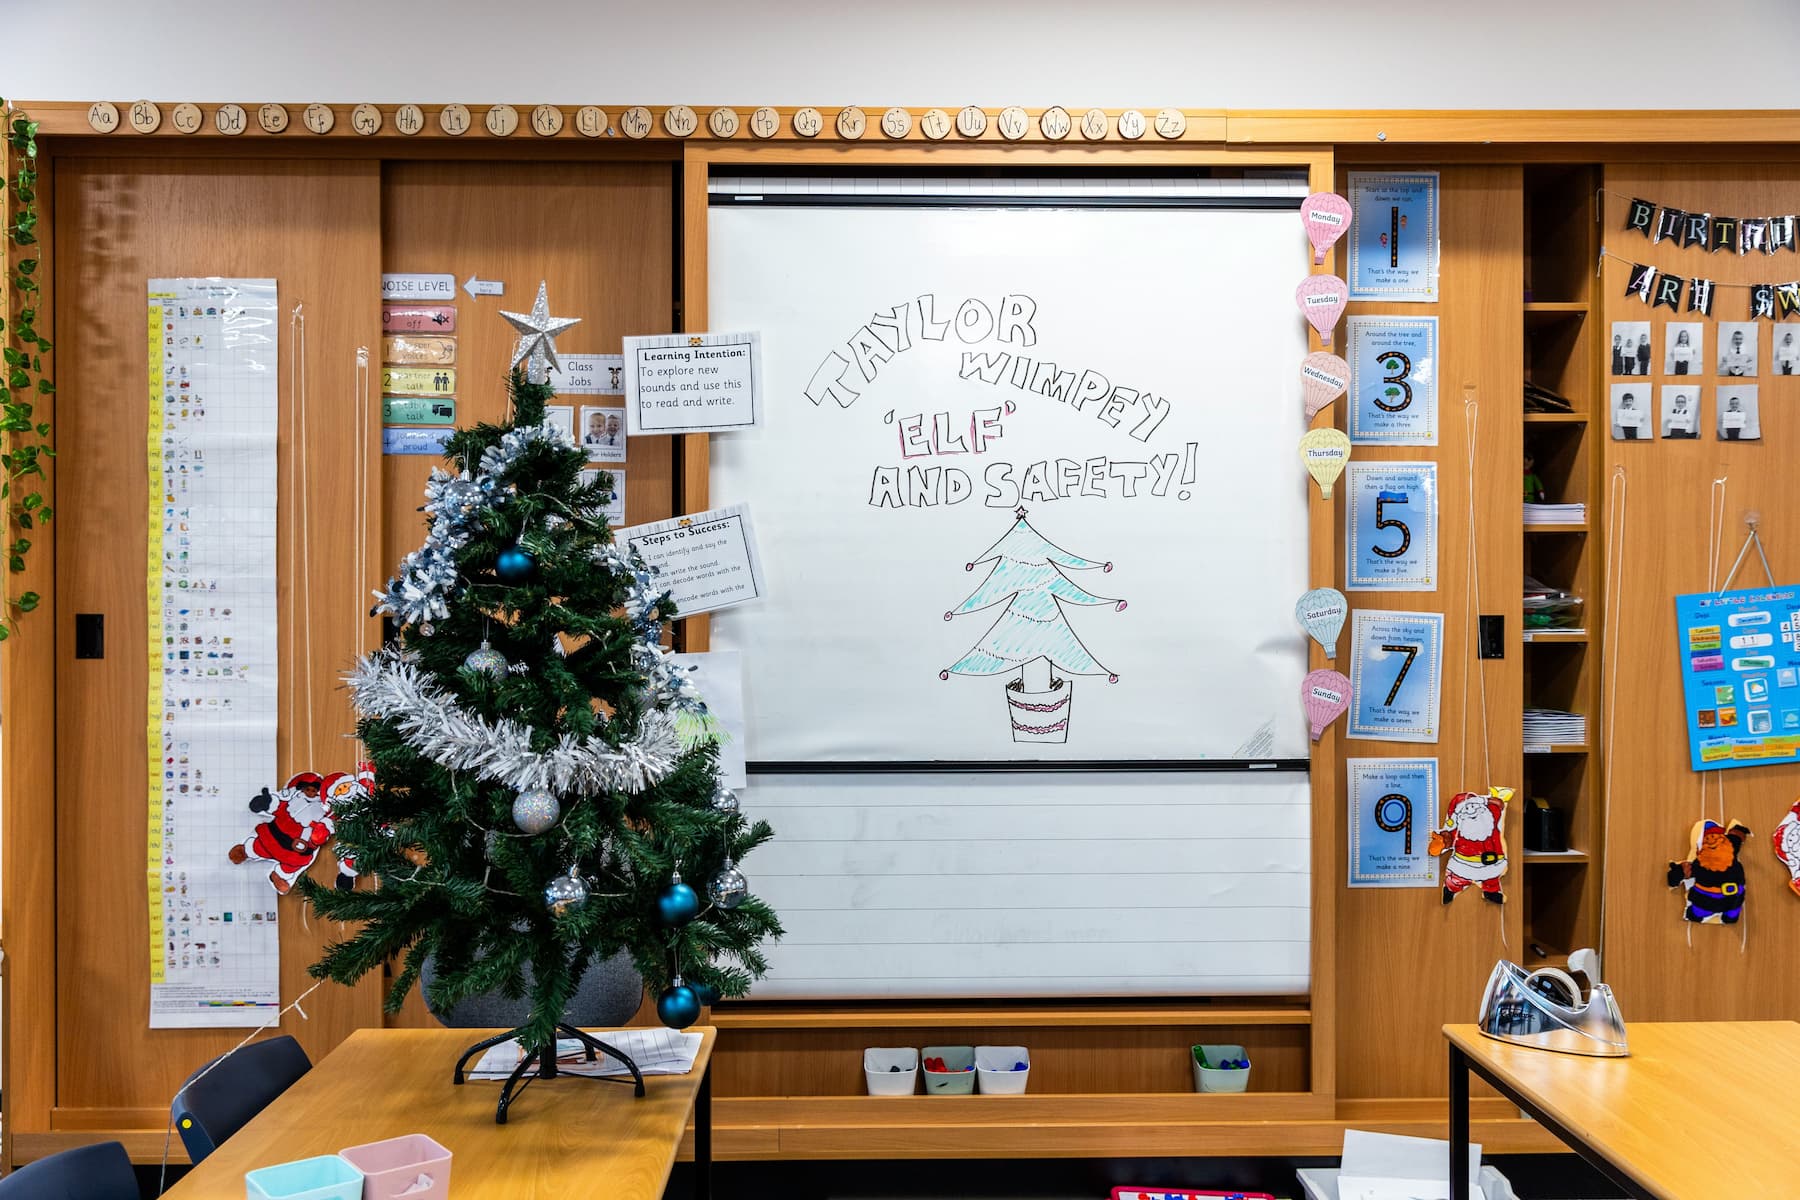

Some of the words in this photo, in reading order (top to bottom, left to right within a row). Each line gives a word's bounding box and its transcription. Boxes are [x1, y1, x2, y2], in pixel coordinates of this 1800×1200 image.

[91, 107, 112, 124] Aa
[134, 105, 154, 125] Bb
[174, 110, 194, 129] Cc
[218, 109, 242, 130] Dd
[263, 108, 280, 128] Ee
[308, 108, 324, 133] Ff
[354, 110, 374, 134] Gg
[400, 110, 418, 130] Hh
[445, 110, 464, 130] Ii
[488, 110, 506, 134] Jj
[536, 109, 556, 131] Kk
[580, 110, 598, 132] Ll
[626, 111, 648, 134] Mm
[668, 110, 690, 131] Nn
[714, 112, 734, 133] Oo
[756, 110, 773, 135] Pp
[797, 112, 818, 136] Qq
[840, 111, 860, 133] Rr
[886, 113, 905, 134] Ss
[924, 115, 946, 135] Tt
[964, 111, 982, 132] Uu
[1002, 113, 1022, 134] Vv
[1044, 114, 1068, 136] Ww
[1084, 112, 1103, 134] Xx
[1122, 112, 1139, 136] Yy
[1158, 117, 1180, 134] Zz
[1311, 212, 1340, 224] Monday
[418, 281, 451, 292] LEVEL
[1307, 295, 1338, 304] Tuesday
[406, 320, 422, 328] off
[644, 352, 690, 362] Learning
[694, 350, 746, 360] Intention:
[804, 294, 1037, 408] TAYLOR
[568, 362, 593, 372] Class
[640, 366, 654, 376] To
[658, 365, 694, 379] explore
[698, 366, 718, 375] new
[384, 374, 392, 387] 2
[568, 376, 592, 386] Jobs
[1304, 367, 1344, 389] Wednesday
[1373, 351, 1412, 412] 3
[406, 383, 424, 391] talk
[640, 381, 676, 392] sounds
[680, 380, 700, 391] and
[704, 382, 720, 390] use
[724, 380, 742, 389] this
[642, 400, 652, 408] to
[656, 398, 678, 408] read
[682, 396, 702, 407] and
[706, 396, 736, 406] write.
[959, 352, 1170, 442] WIMPEY
[384, 404, 392, 417] 3
[402, 442, 428, 452] proud
[1308, 449, 1343, 458] Thursday
[869, 465, 972, 508] AND
[984, 442, 1198, 508] SAFETY!
[642, 534, 671, 546] Steps
[674, 530, 686, 540] to
[688, 520, 730, 537] Success:
[1372, 496, 1411, 558] 5
[666, 547, 690, 558] identify
[692, 543, 704, 552] and
[671, 568, 686, 577] write
[672, 575, 694, 585] decode
[696, 571, 715, 580] words
[716, 568, 730, 576] with
[700, 589, 719, 598] words
[720, 586, 734, 594] with
[1306, 606, 1342, 620] Saturday
[1382, 644, 1418, 706] 7
[1312, 688, 1340, 702] Sunday
[1374, 793, 1412, 854] 9
